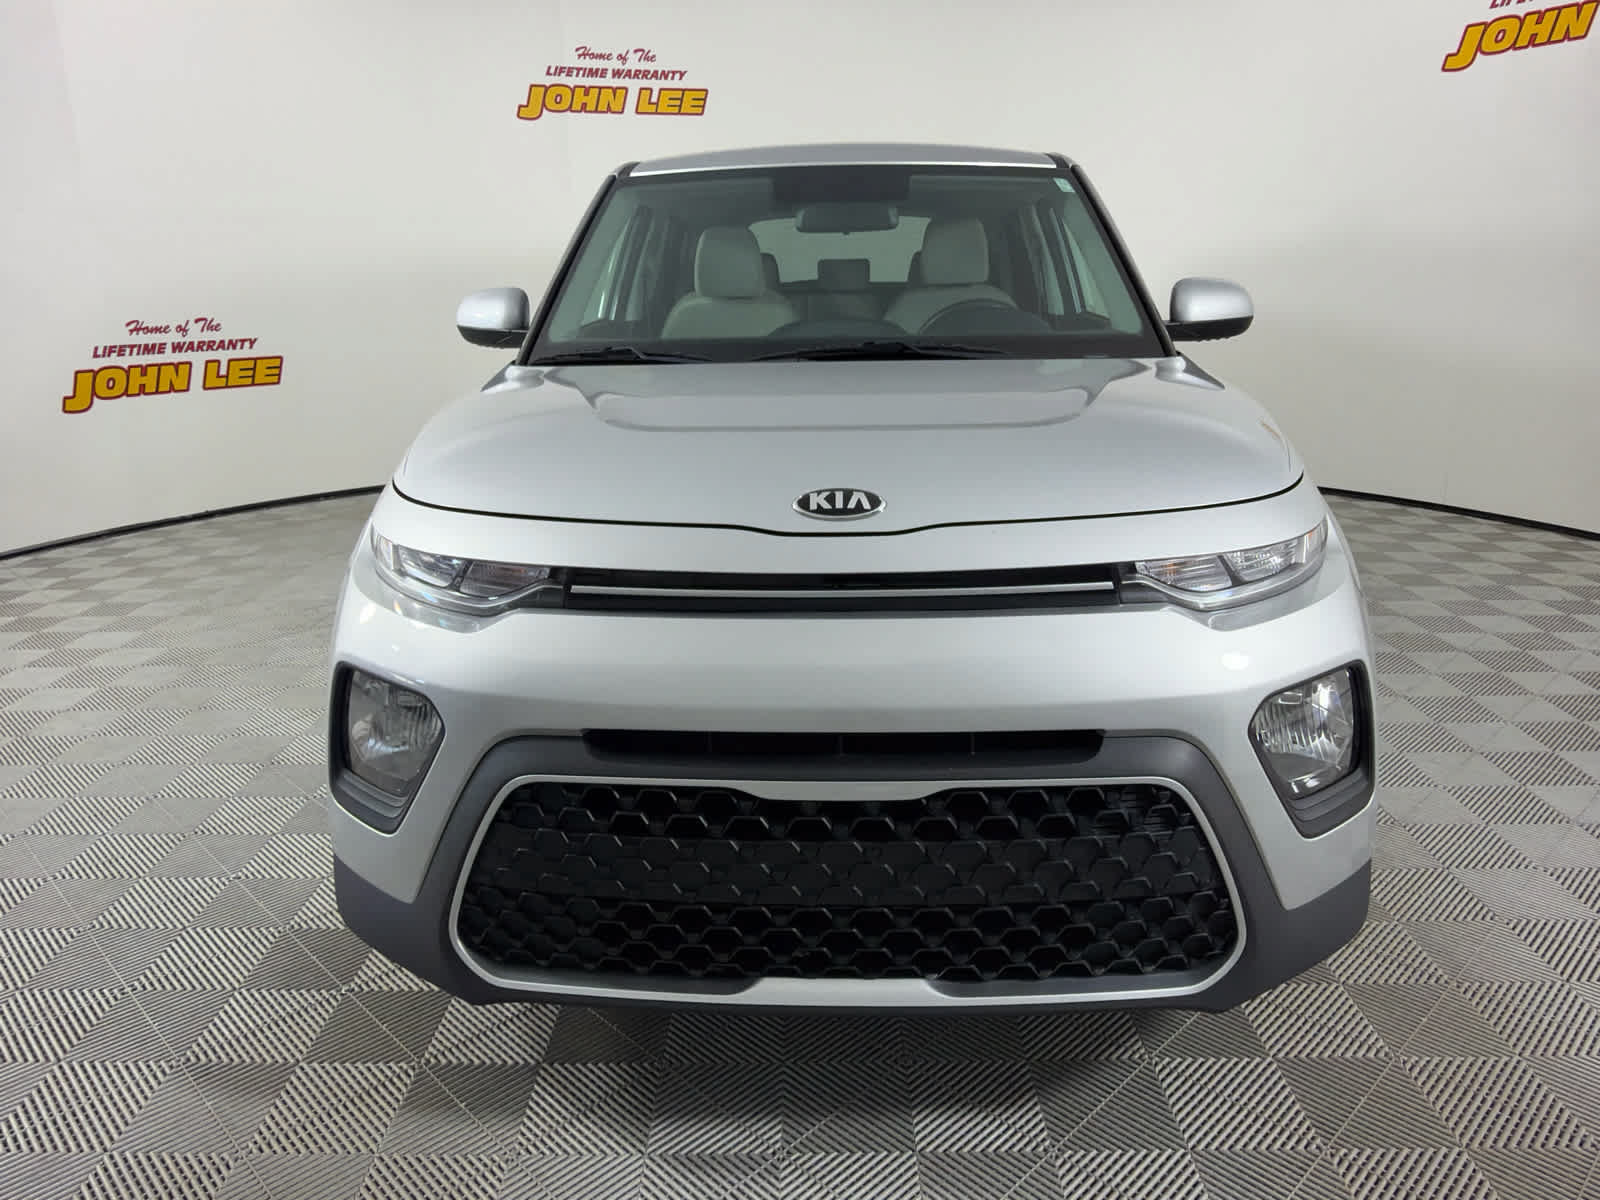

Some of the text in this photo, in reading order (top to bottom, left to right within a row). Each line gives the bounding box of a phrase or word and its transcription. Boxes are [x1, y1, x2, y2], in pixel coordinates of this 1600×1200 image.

[1441, 0, 1600, 72] JOHN
[575, 46, 656, 66] Home of The
[545, 65, 687, 81] LIFETIME WARRANTY
[517, 83, 709, 121] JOHN LEE
[125, 317, 222, 337] Home of The
[92, 337, 258, 358] LIFETIME WARRANTY
[62, 355, 284, 414] JOHN LEE
[809, 490, 872, 511] KIA
